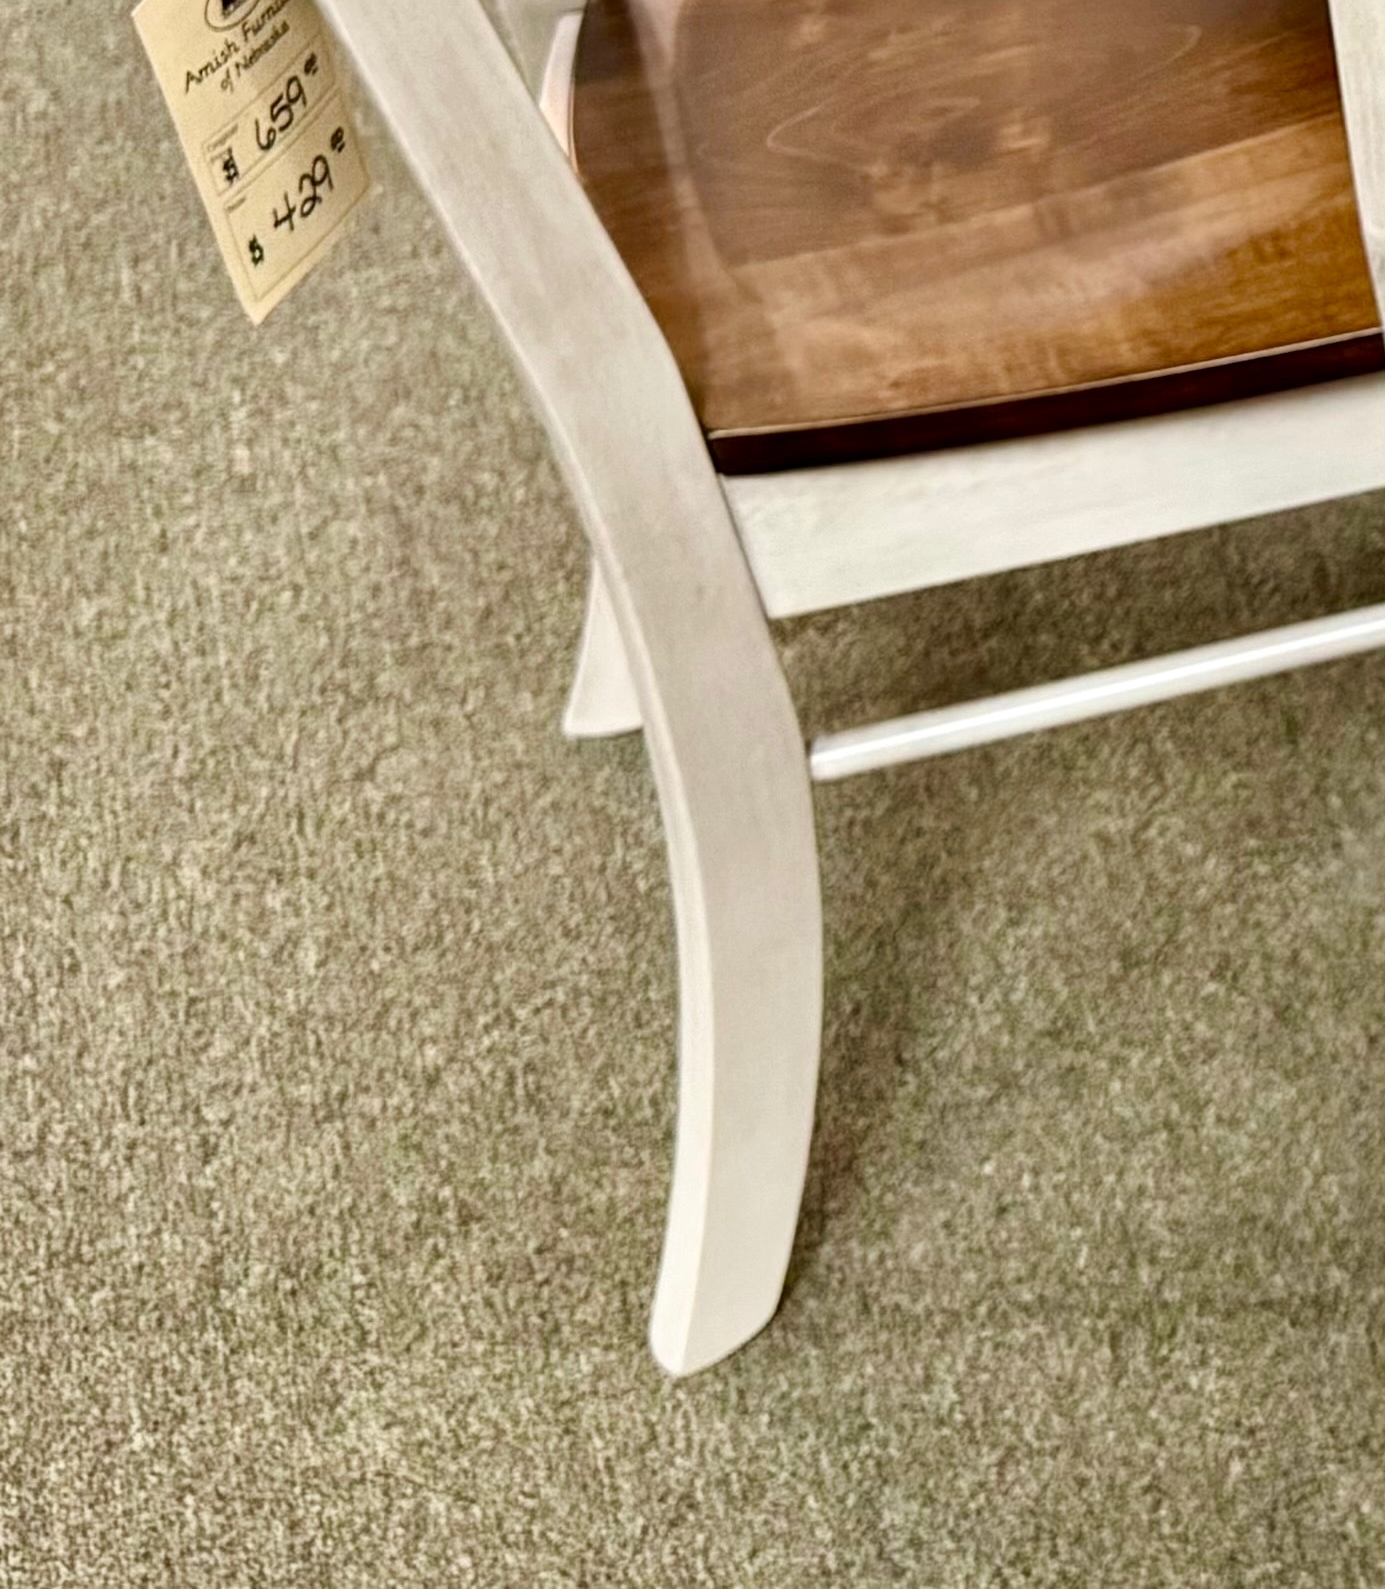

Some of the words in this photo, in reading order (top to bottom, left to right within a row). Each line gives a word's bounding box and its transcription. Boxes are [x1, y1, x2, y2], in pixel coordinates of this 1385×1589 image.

[185, 38, 240, 94] Amish
[220, 68, 234, 94] of
[255, 74, 308, 151] 659
[273, 154, 335, 232] 429
